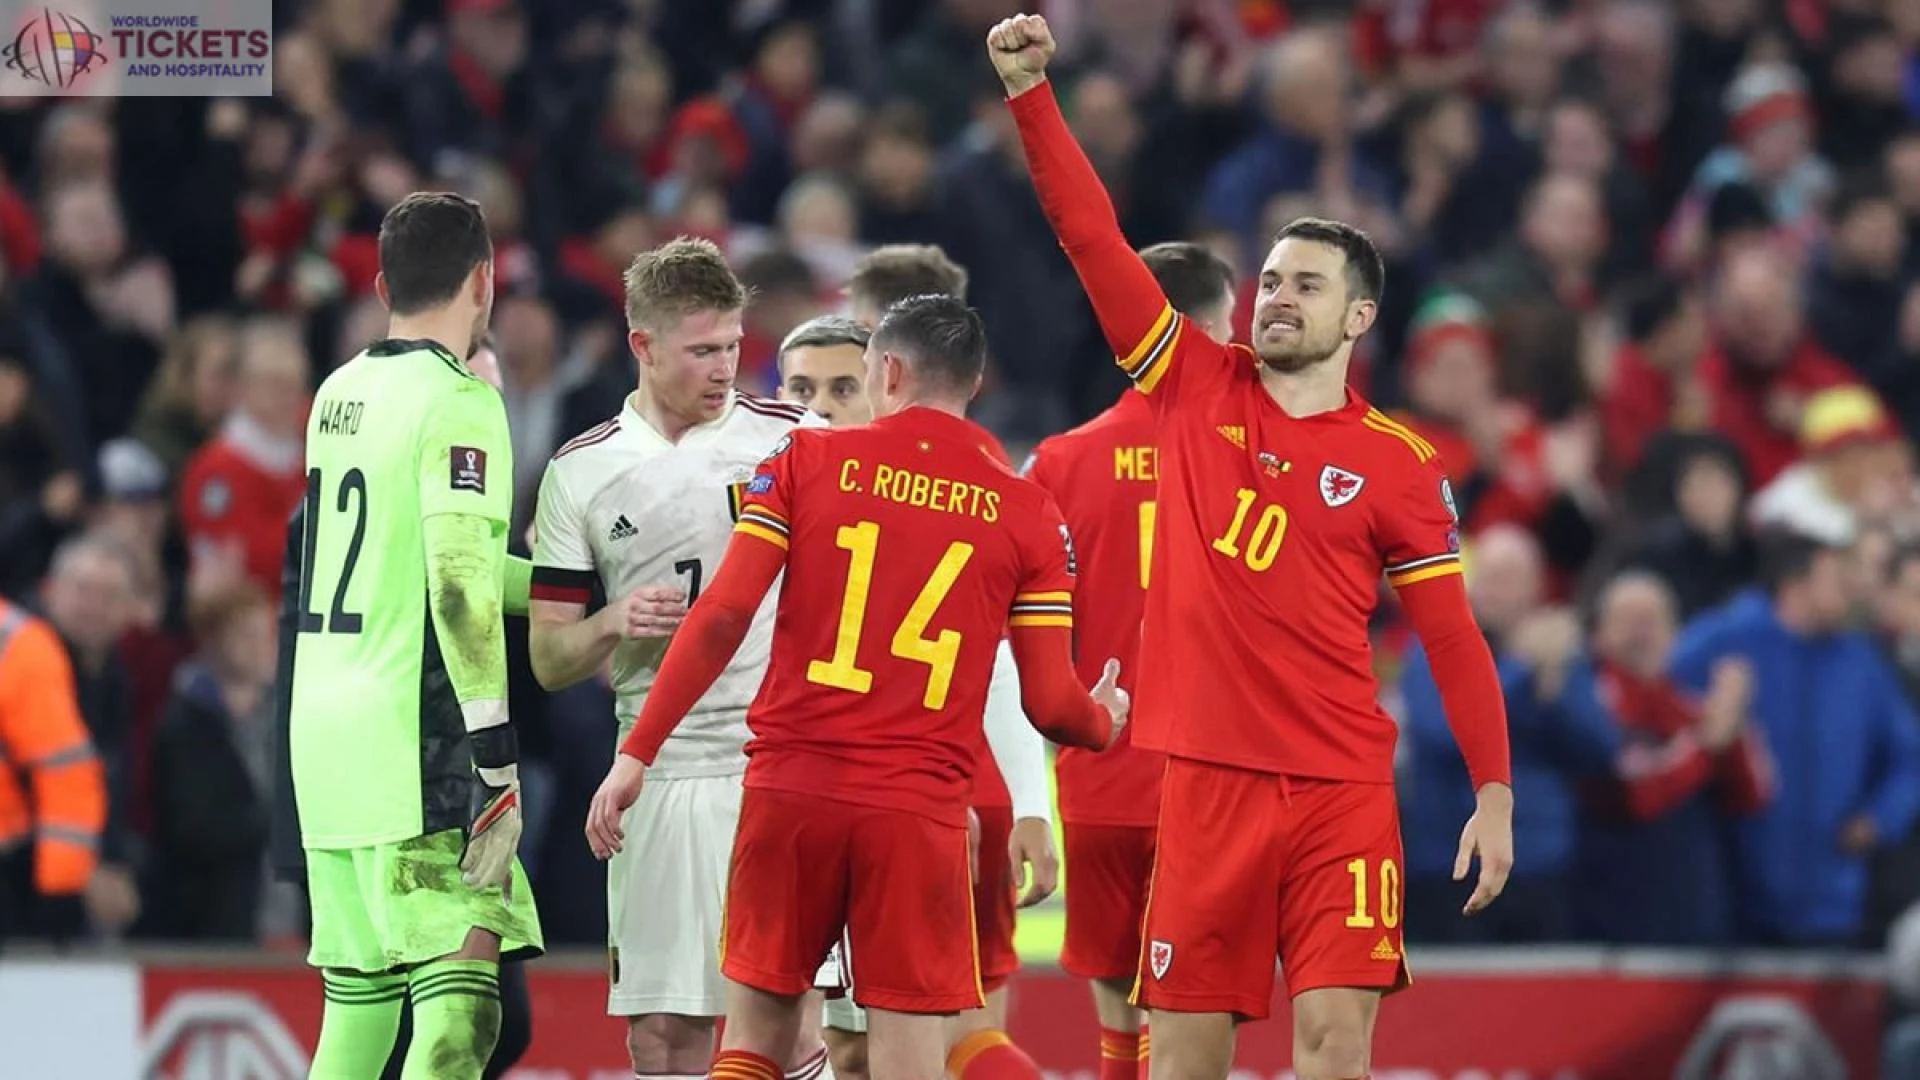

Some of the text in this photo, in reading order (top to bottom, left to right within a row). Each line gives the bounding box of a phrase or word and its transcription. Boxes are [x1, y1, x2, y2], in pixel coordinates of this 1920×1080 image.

[319, 400, 365, 435] WARD
[839, 459, 1001, 523] C. ROBERTS
[298, 467, 367, 633] 12
[1212, 488, 1288, 572] 10
[674, 559, 703, 609] 7
[806, 520, 975, 711] 14
[1345, 858, 1399, 929] 10
